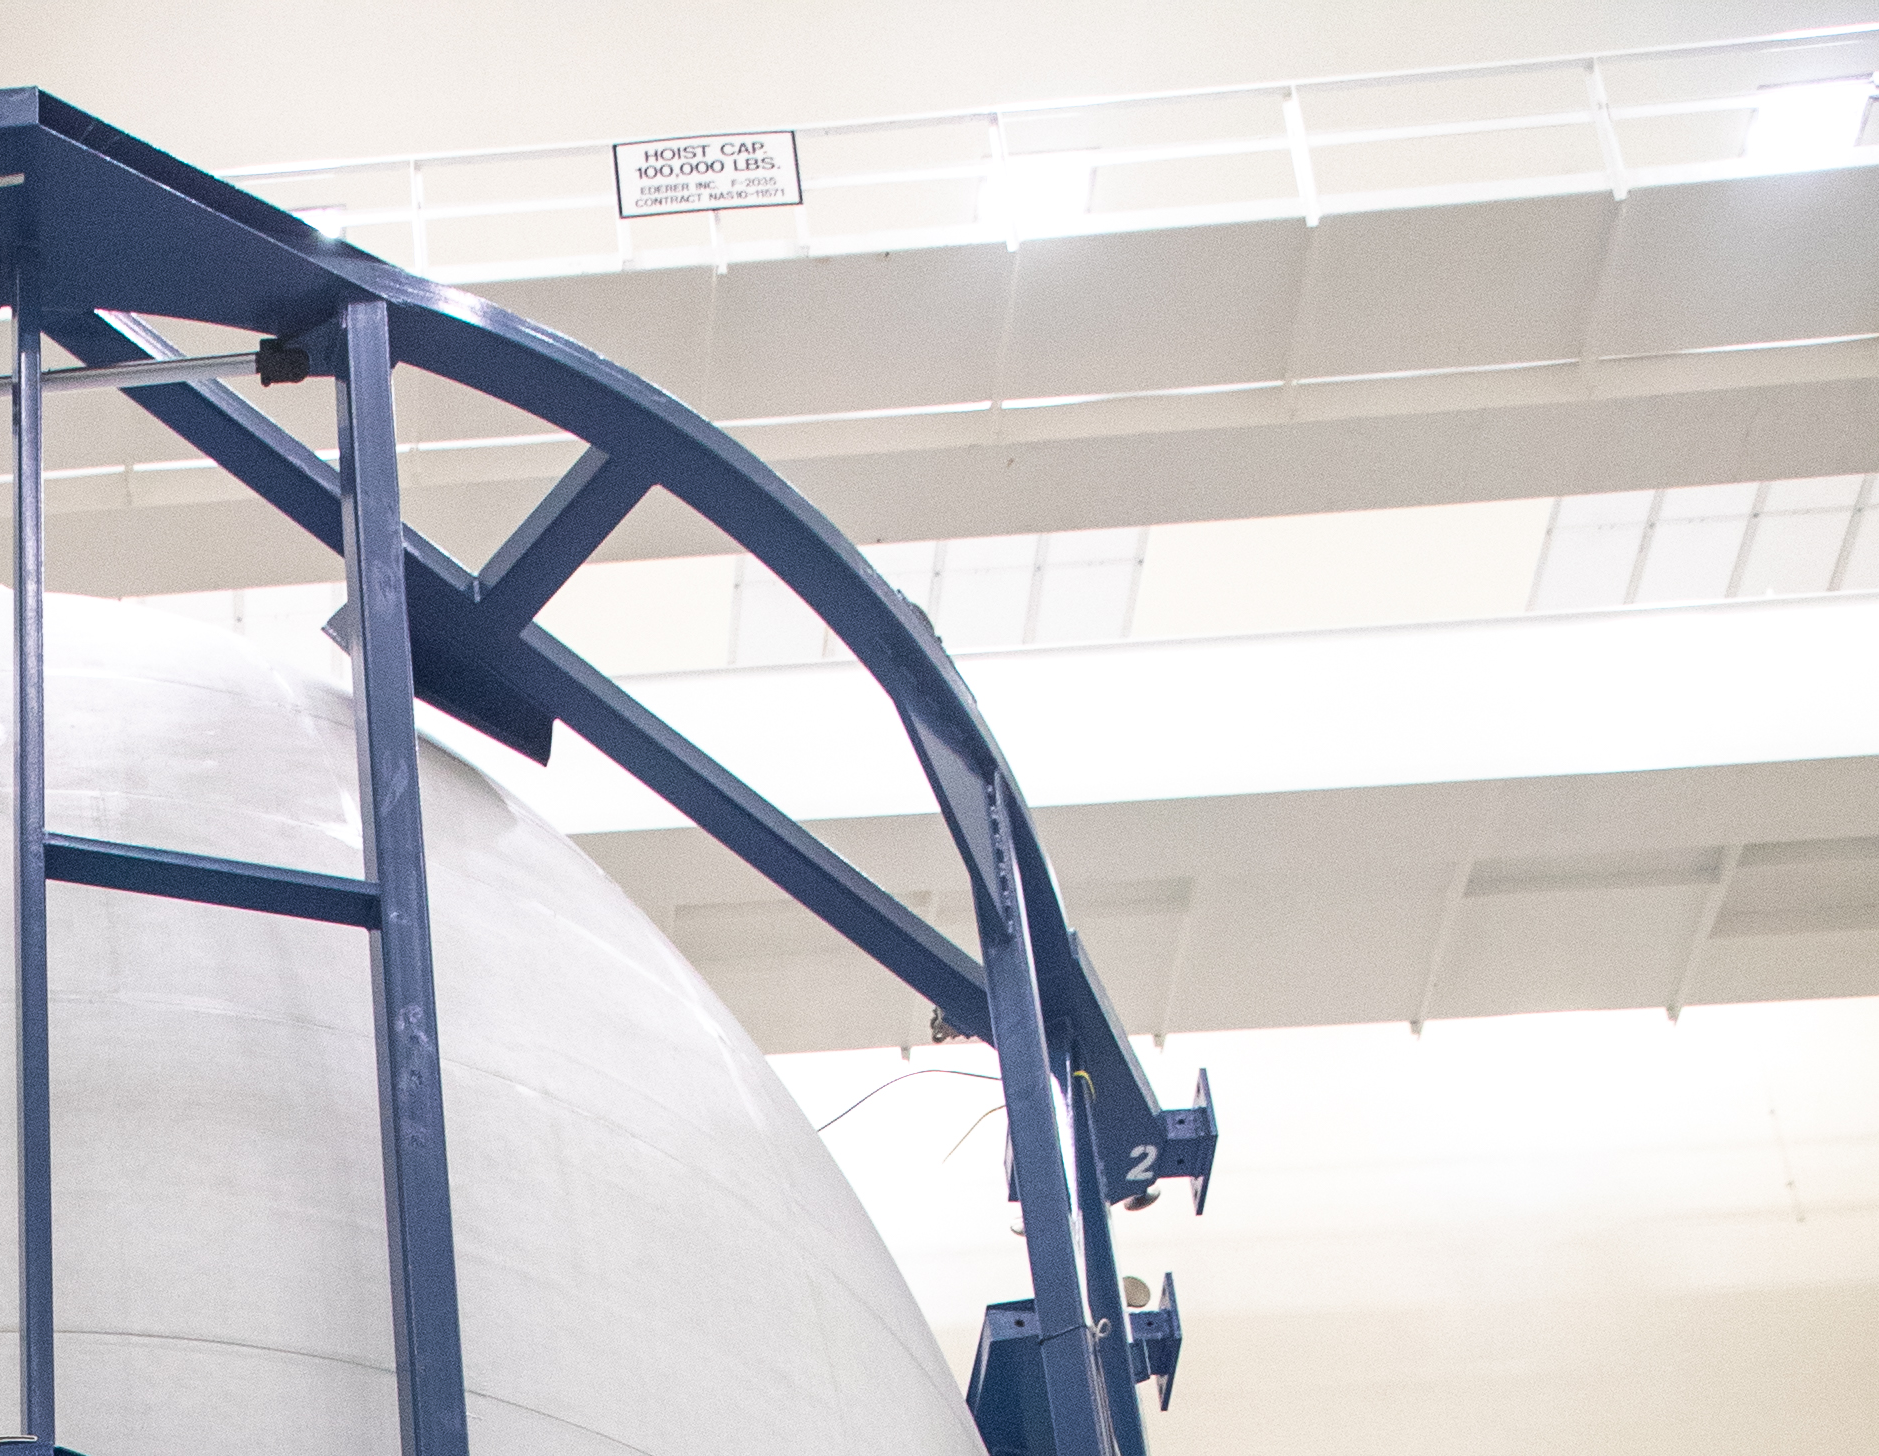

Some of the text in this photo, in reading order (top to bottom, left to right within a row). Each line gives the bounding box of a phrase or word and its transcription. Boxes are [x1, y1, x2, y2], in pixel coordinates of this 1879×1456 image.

[644, 141, 767, 163] HOIST CAP.
[635, 157, 781, 180] 100,000 LBS.
[640, 182, 689, 195] EDERER
[635, 193, 702, 209] CONTRACT
[1125, 1144, 1158, 1181] 2
